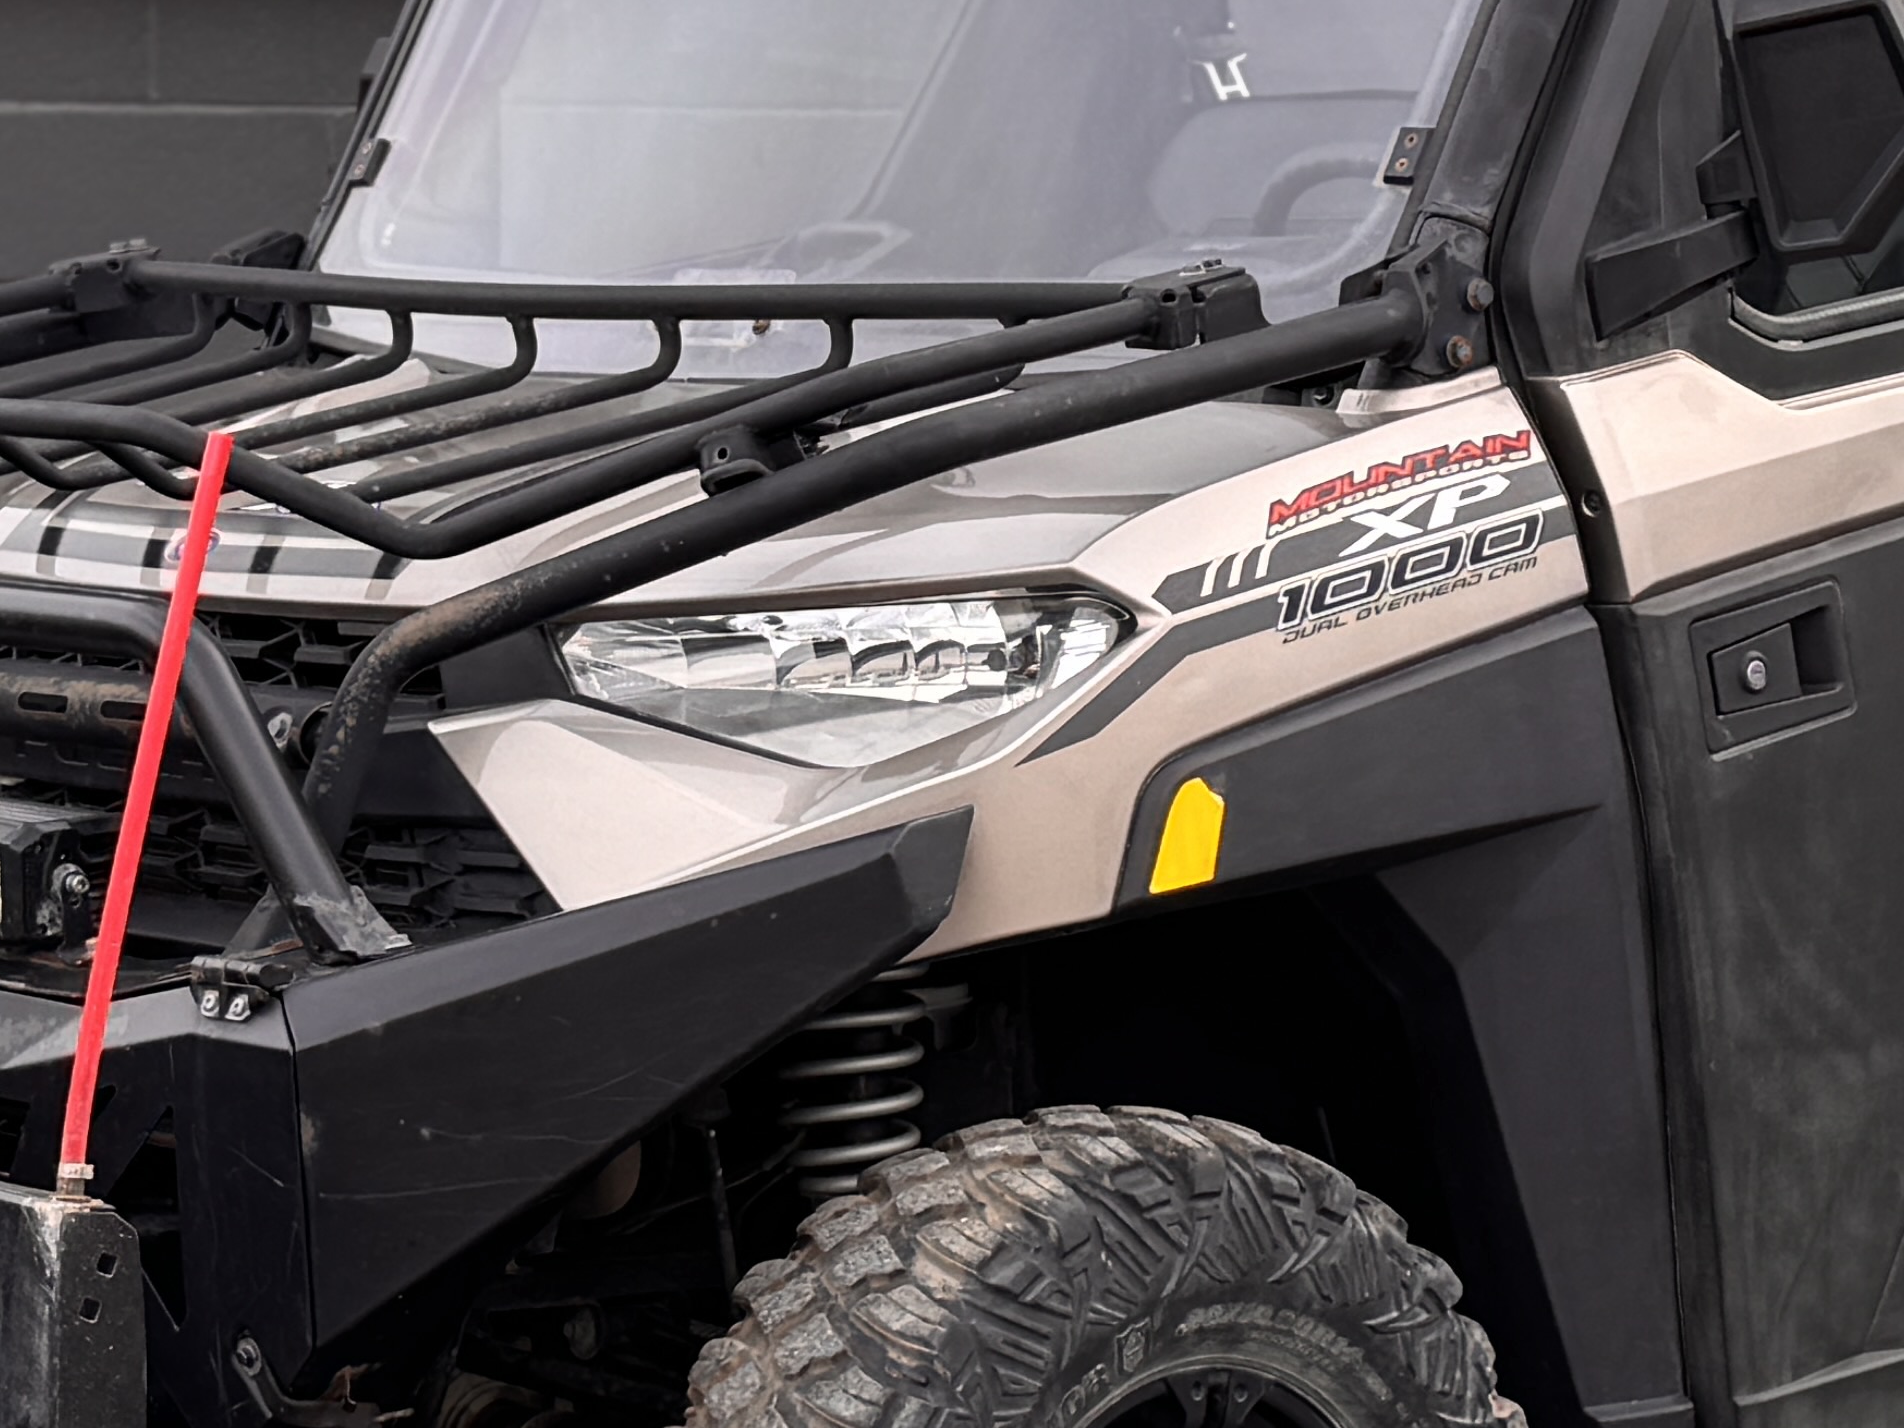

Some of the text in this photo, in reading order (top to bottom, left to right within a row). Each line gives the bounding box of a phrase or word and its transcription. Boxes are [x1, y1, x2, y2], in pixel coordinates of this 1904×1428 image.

[1266, 450, 1531, 539] MOTORSPORTS
[1270, 430, 1531, 526] MOUNTAIN
[1338, 471, 1511, 557] XP
[1277, 508, 1544, 631] 1000
[1283, 556, 1538, 644] DUAL OVERHEAD CAM
